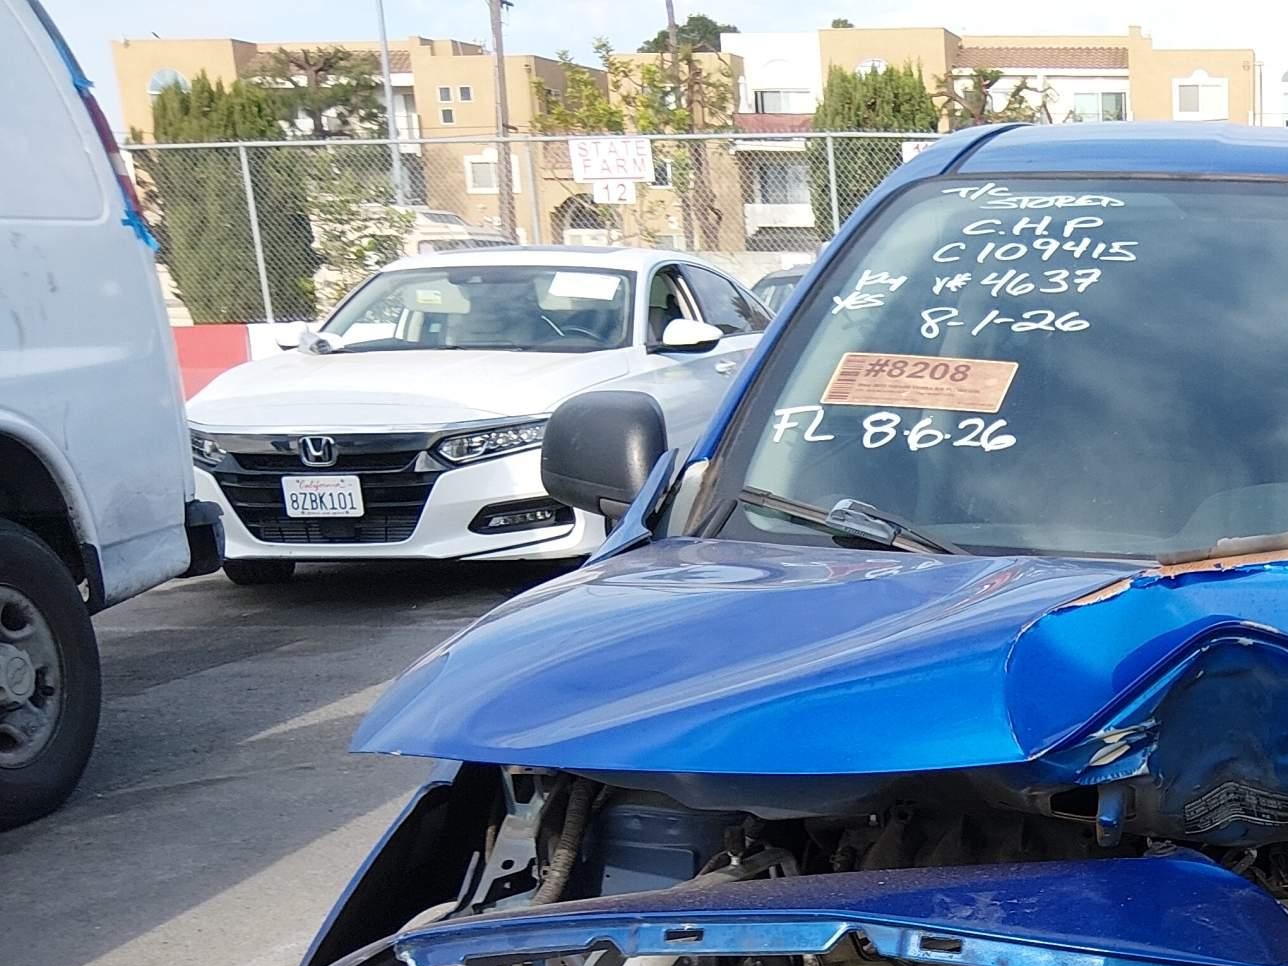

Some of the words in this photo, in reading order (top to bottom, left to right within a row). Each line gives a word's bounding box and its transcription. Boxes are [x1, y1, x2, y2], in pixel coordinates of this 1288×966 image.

[577, 140, 647, 158] STATE
[583, 158, 647, 176] FARM
[603, 183, 628, 202] 12
[979, 194, 1126, 210] STORED
[980, 268, 1102, 297] 4637
[864, 358, 972, 383] #8208
[773, 405, 836, 443] FL
[290, 492, 357, 511] 8ZBK101
